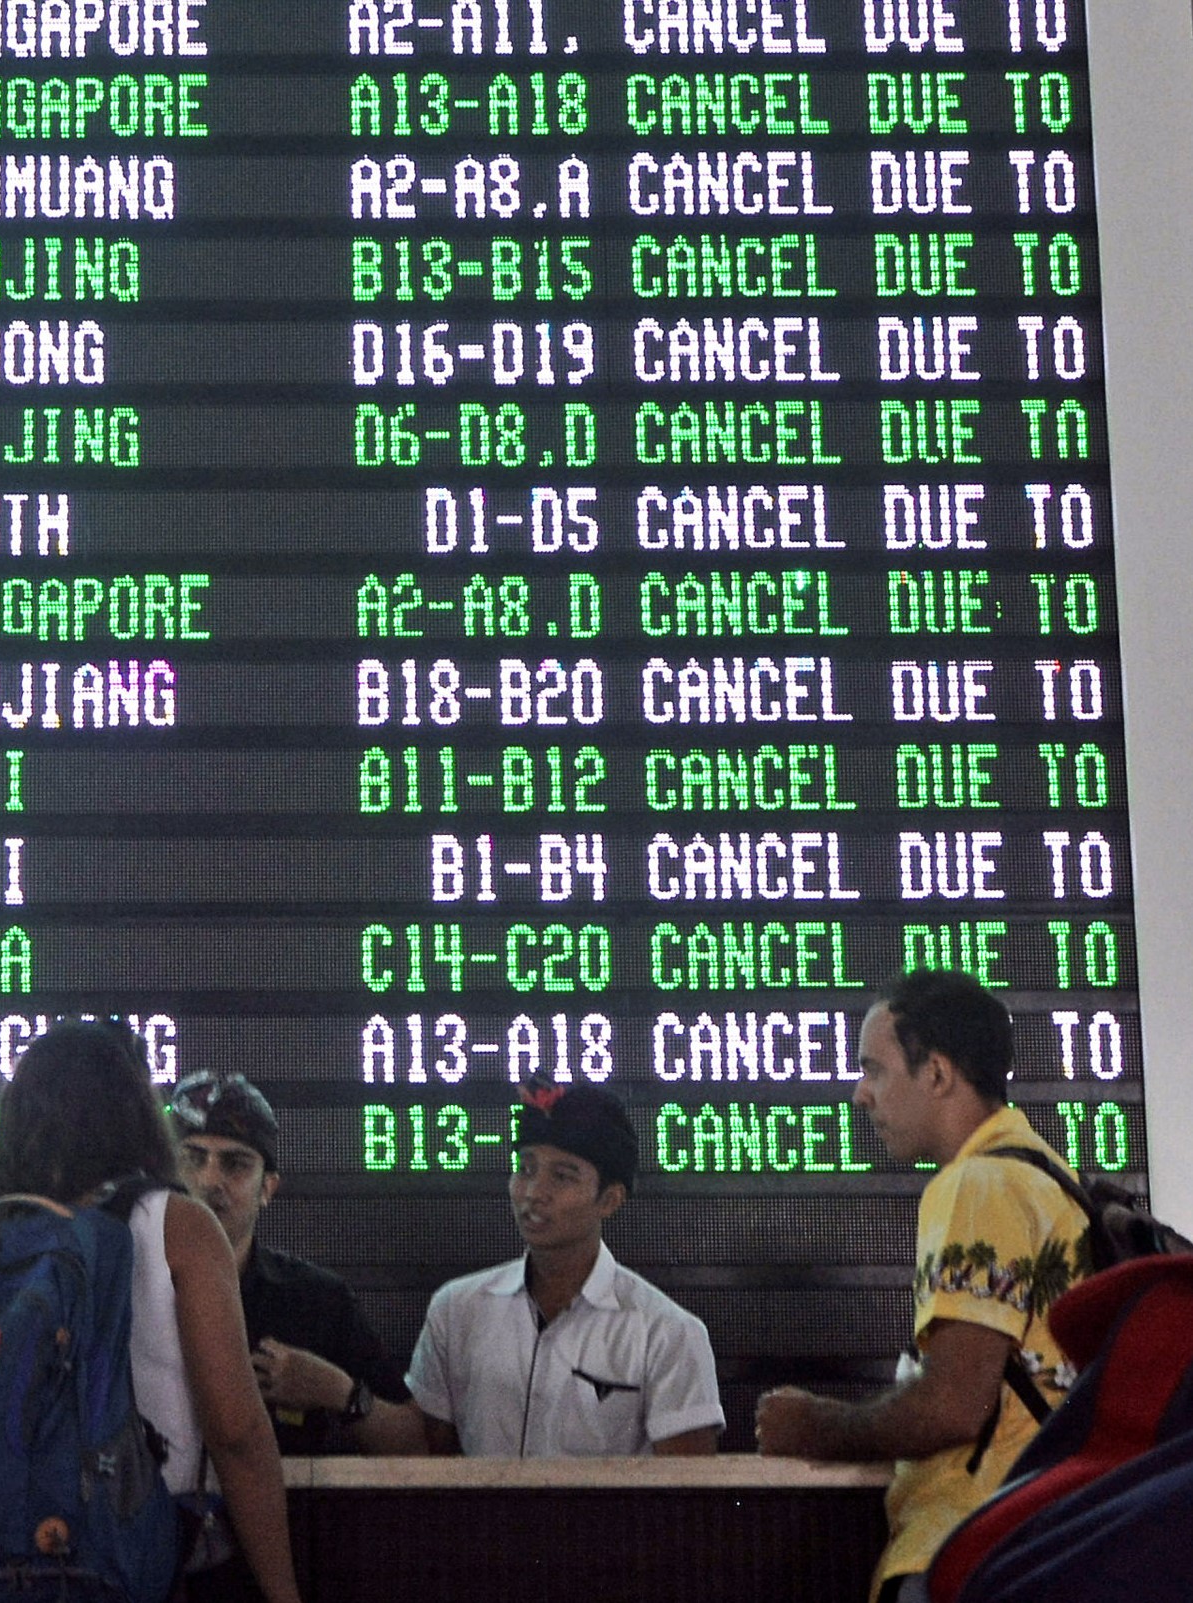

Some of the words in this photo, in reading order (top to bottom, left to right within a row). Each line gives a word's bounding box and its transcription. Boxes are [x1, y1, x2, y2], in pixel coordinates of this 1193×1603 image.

[623, 0, 827, 55] CANCEL
[863, 0, 965, 53] DUE
[1008, 0, 1067, 53] TO
[350, 72, 588, 136] A13-A18
[626, 72, 830, 136] CANCEL
[867, 72, 968, 134] DUE
[1004, 71, 1071, 134] TO
[628, 150, 834, 216] CANCEL
[870, 150, 973, 215] DUE
[1008, 149, 1076, 214] TO
[352, 236, 592, 302] B13-B15
[631, 234, 837, 298] CANCEL
[874, 233, 977, 297] DUE
[1013, 232, 1080, 296] TO
[352, 319, 595, 386] D16-D19
[633, 316, 841, 383] CANCEL
[877, 315, 981, 382] DUE
[1017, 315, 1086, 381] TO
[635, 400, 842, 465] CANCEL
[880, 399, 982, 464] DUE
[425, 486, 599, 554] D1-D5
[636, 484, 846, 551] CANCEL
[883, 483, 988, 550] DUE
[1024, 483, 1094, 549] TO
[640, 569, 849, 637] CANCEL
[887, 570, 991, 634] DUE
[1030, 573, 1098, 635] TO
[356, 658, 604, 727] B18-B20
[641, 656, 854, 725] CANCEL
[891, 660, 996, 723] DUE
[1034, 659, 1103, 721] TO
[359, 746, 606, 813] B11-B12
[645, 744, 857, 811] CANCEL
[896, 743, 1001, 808] DUE
[1038, 743, 1108, 808] TO
[430, 833, 608, 904] B1-B4
[646, 831, 861, 901] CANCEL
[898, 831, 1006, 900] DUE
[1042, 831, 1113, 899] TO
[361, 923, 611, 993] C14-C20
[650, 921, 865, 991] CANCEL
[903, 921, 1009, 989] DUE
[1047, 921, 1117, 989] TO
[360, 1012, 615, 1084] A13-A18
[652, 1011, 868, 1083] CANCEL
[1051, 1010, 1123, 1081] TO
[363, 1104, 524, 1173] B13-
[656, 1102, 871, 1172] CANCEL
[1057, 1101, 1128, 1171] TO
